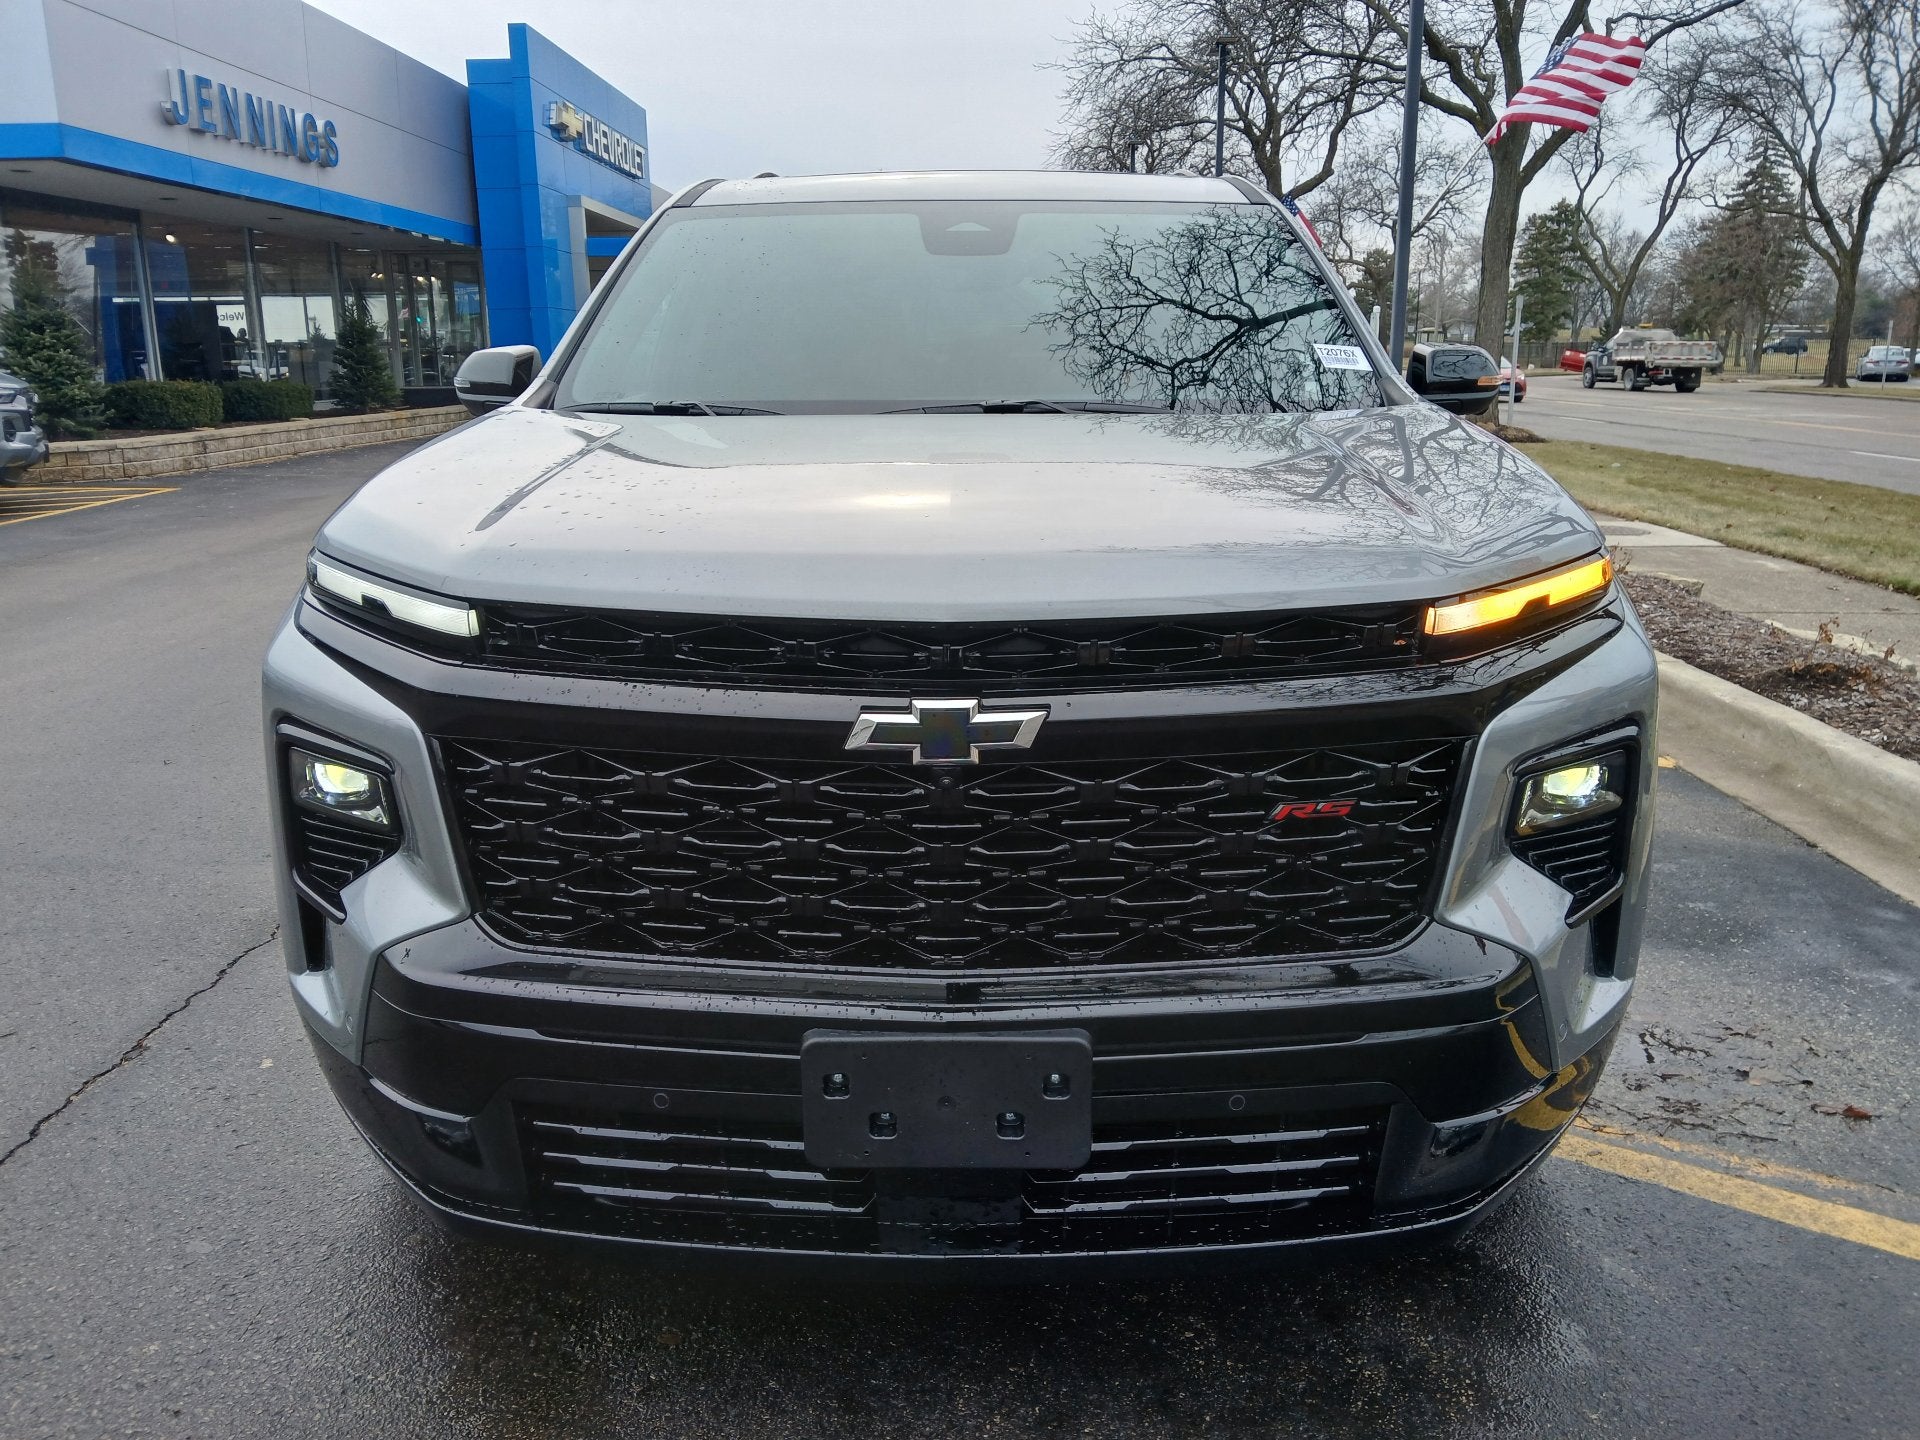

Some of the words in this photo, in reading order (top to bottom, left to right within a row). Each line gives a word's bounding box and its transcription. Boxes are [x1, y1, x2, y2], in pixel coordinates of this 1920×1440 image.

[161, 68, 339, 168] JENNINGS
[583, 112, 646, 179] CHEVROLET
[1317, 347, 1358, 358] T2076X
[1269, 800, 1356, 821] RS
